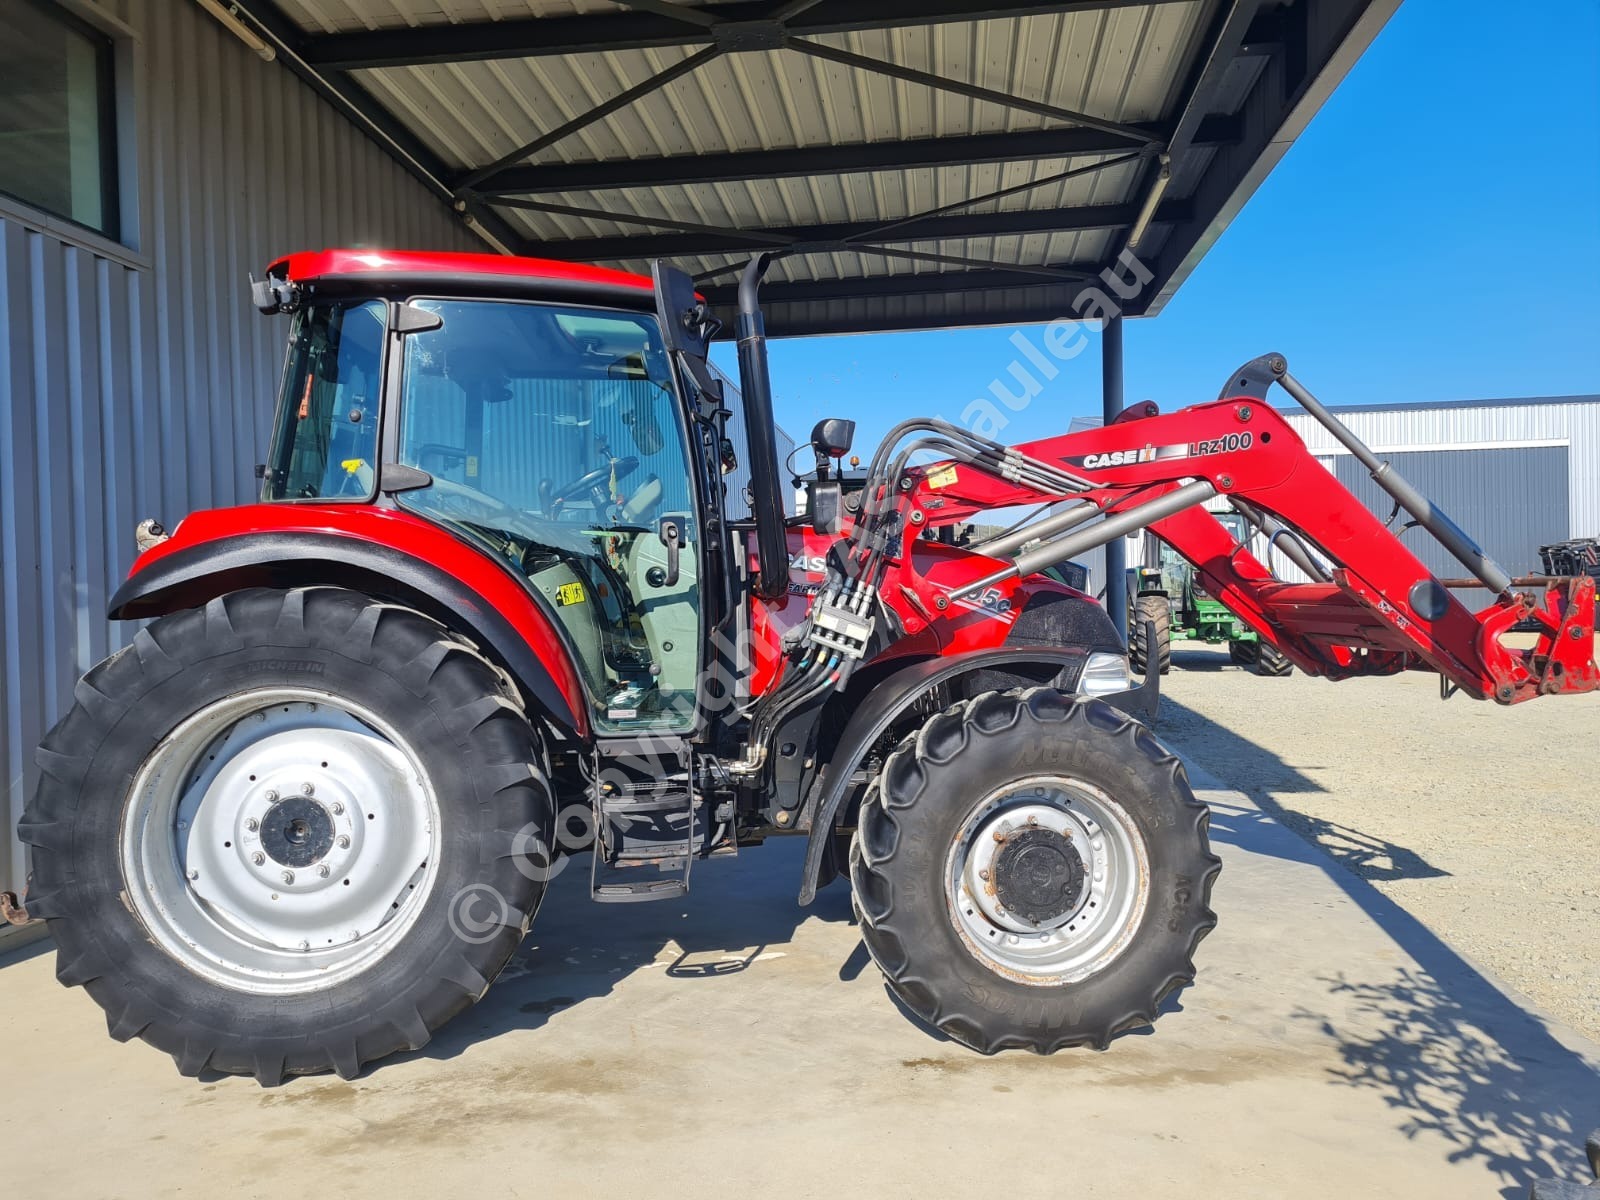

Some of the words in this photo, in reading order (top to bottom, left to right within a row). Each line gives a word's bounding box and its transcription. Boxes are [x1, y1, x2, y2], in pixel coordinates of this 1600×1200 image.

[1083, 450, 1138, 469] CASE
[1188, 431, 1253, 458] LRZ100
[788, 553, 828, 572] AS
[247, 660, 326, 674] MICHELIN
